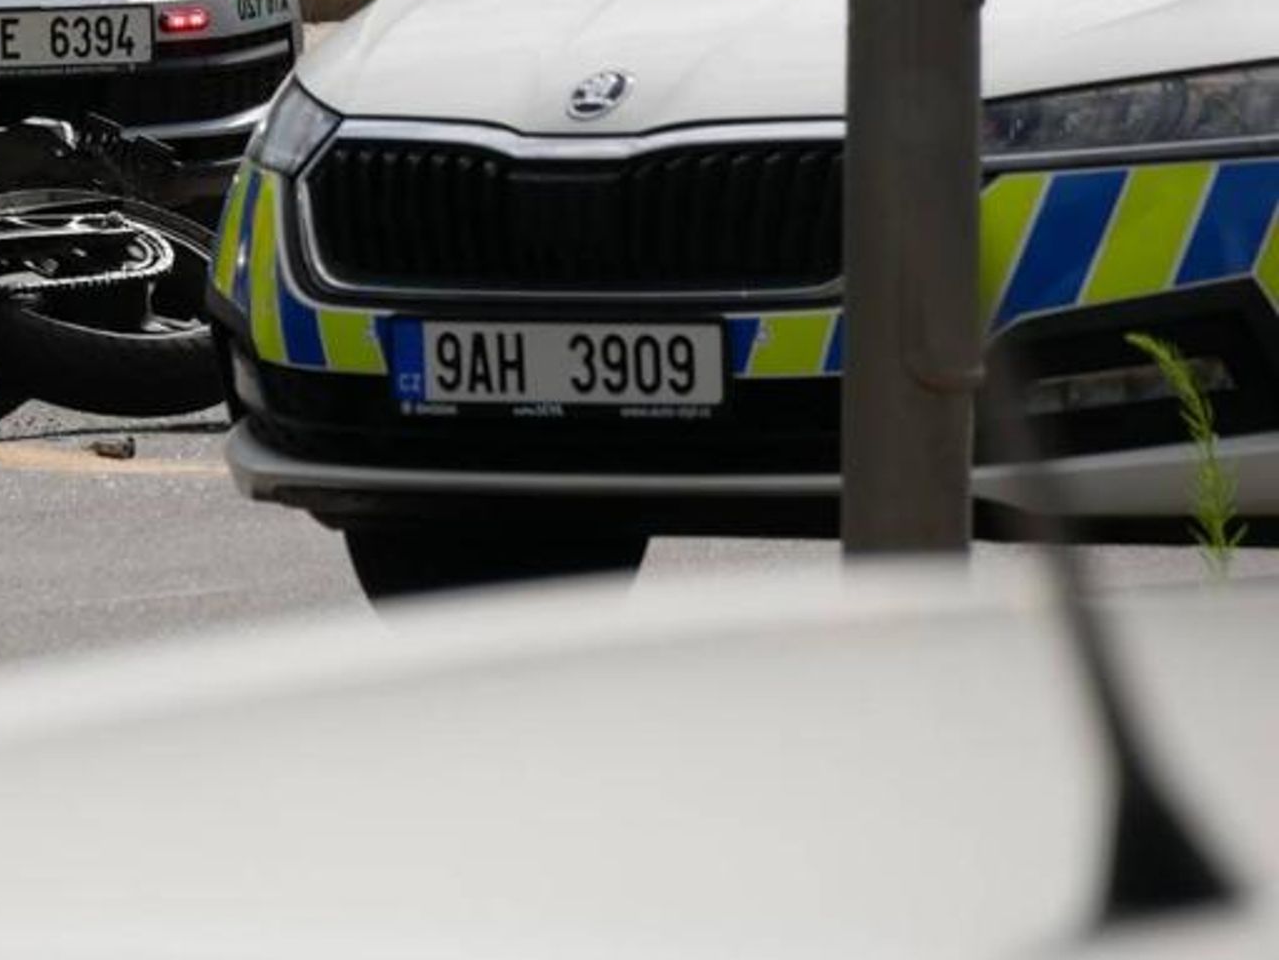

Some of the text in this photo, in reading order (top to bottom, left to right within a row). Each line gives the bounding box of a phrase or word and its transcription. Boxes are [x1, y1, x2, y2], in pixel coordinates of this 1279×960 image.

[49, 14, 135, 59] 6394
[435, 330, 696, 396] 9AH 3909
